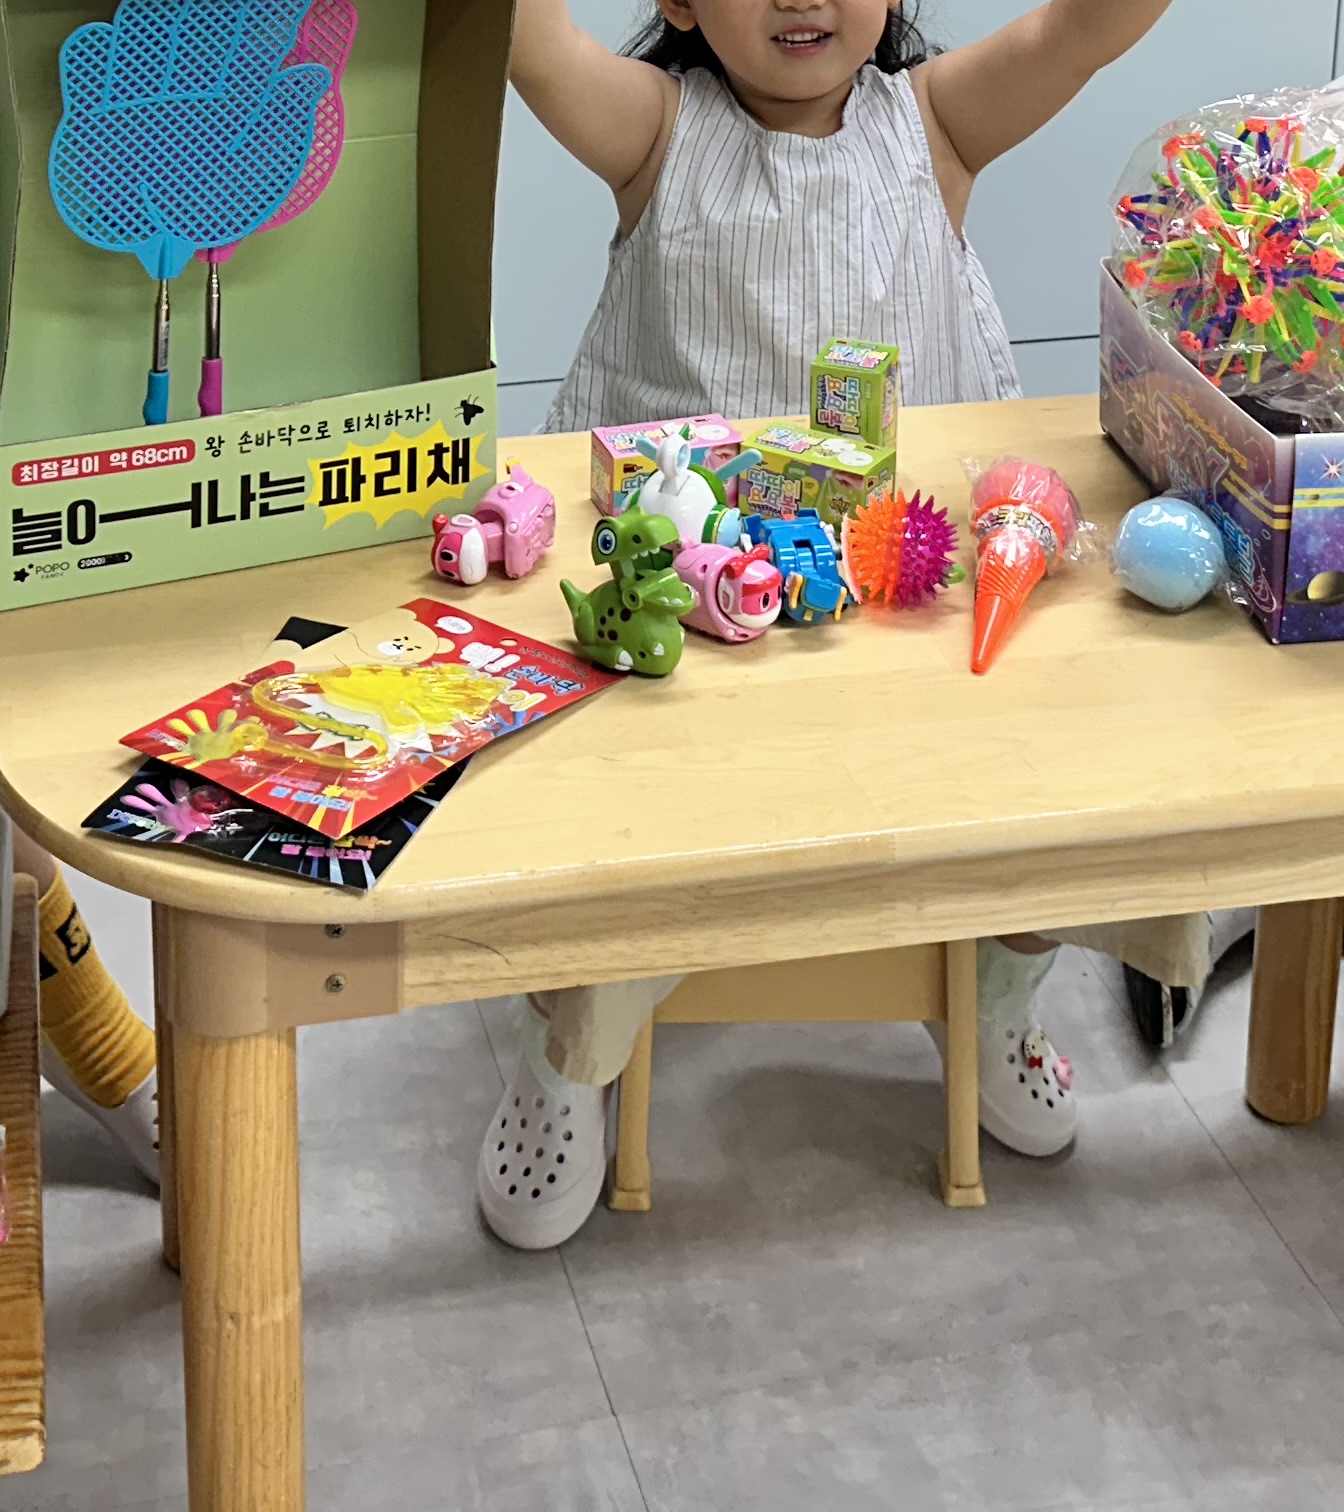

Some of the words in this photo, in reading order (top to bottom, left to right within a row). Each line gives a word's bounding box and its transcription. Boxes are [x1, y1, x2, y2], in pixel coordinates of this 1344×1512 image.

[204, 435, 225, 458] 왕
[238, 421, 331, 454] 손바닥으로
[343, 403, 431, 434] 퇴치하자!
[20, 455, 99, 483] 최장길이
[110, 452, 128, 468] 약
[132, 445, 188, 467] 68cm
[319, 437, 471, 507] 파리채
[36, 562, 70, 575] POPO
